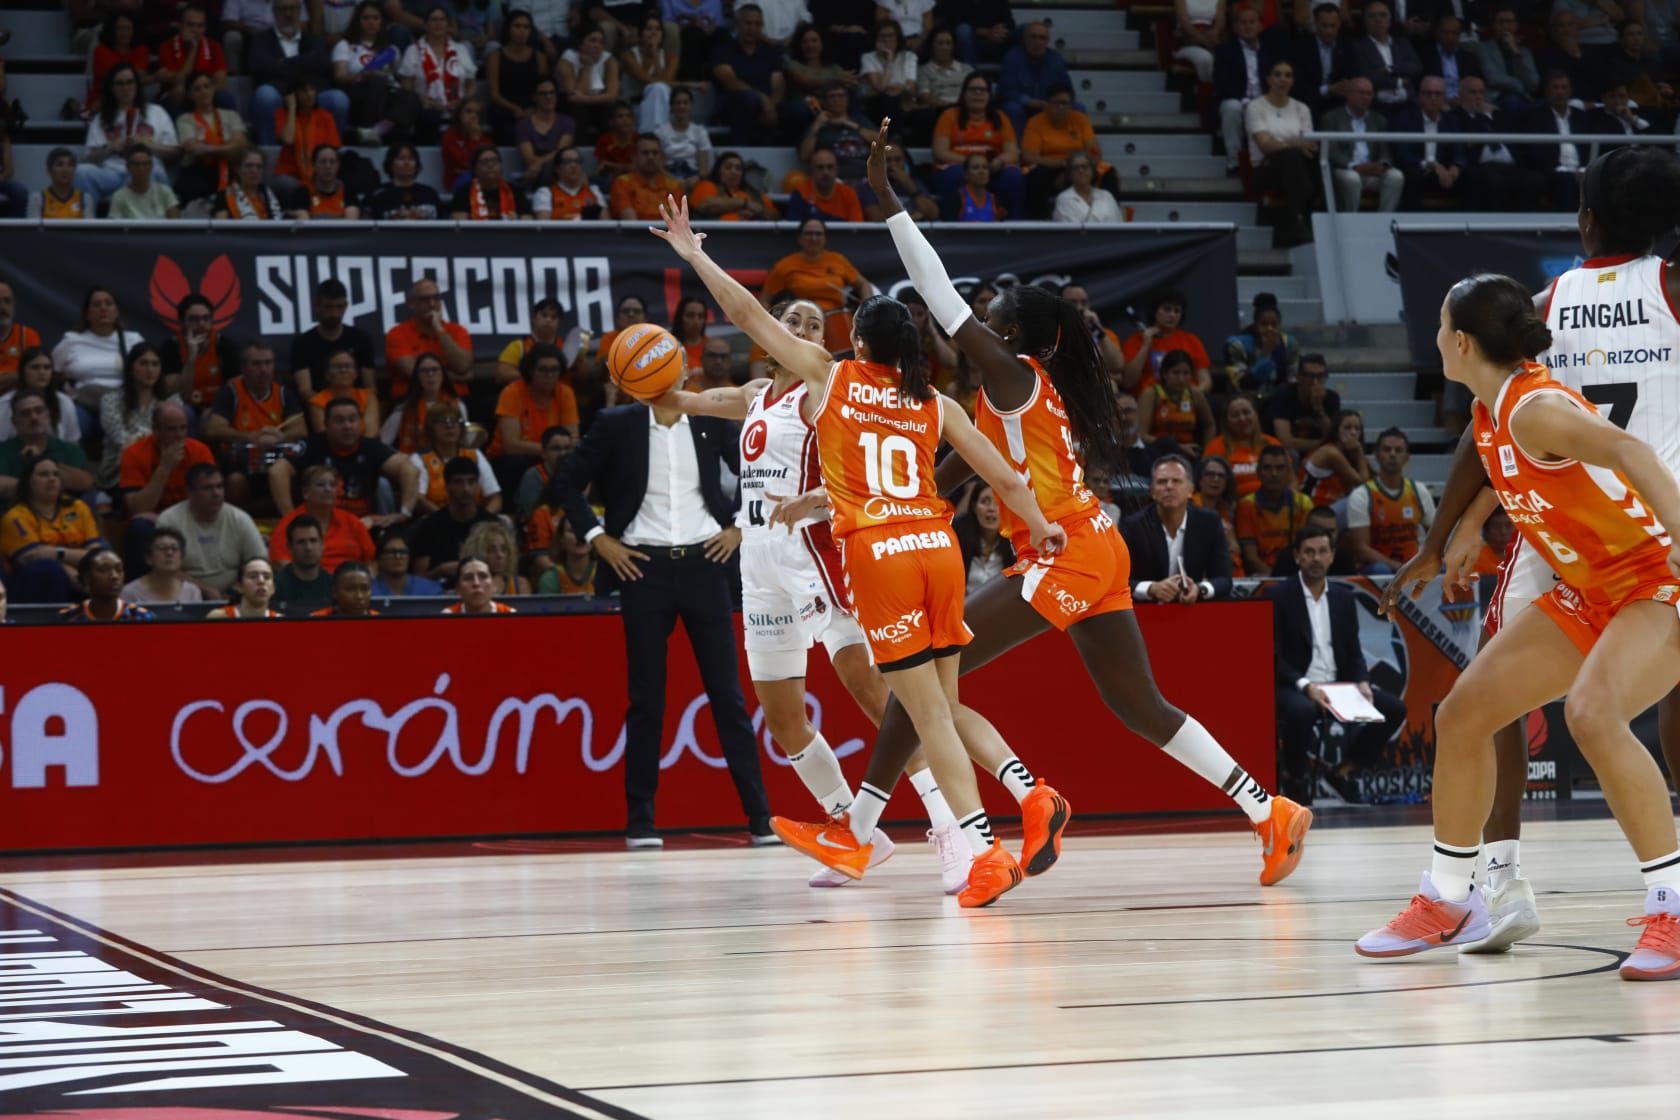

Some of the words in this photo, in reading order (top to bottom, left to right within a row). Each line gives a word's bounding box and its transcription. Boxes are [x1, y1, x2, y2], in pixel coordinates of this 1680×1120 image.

[1559, 299, 1650, 331] FINGALL
[1546, 354, 1568, 369] AIR
[1573, 348, 1672, 367] HORIZONT
[1581, 382, 1639, 430] 7
[858, 431, 921, 499] 10
[872, 499, 933, 518] Midea
[871, 530, 952, 560] PAMESA
[1537, 530, 1578, 564] 6
[748, 612, 793, 627] Silken
[869, 620, 909, 642] MGS
[755, 629, 785, 637] HOTELES
[0, 682, 99, 788] A
[1531, 789, 1557, 799] 2025
